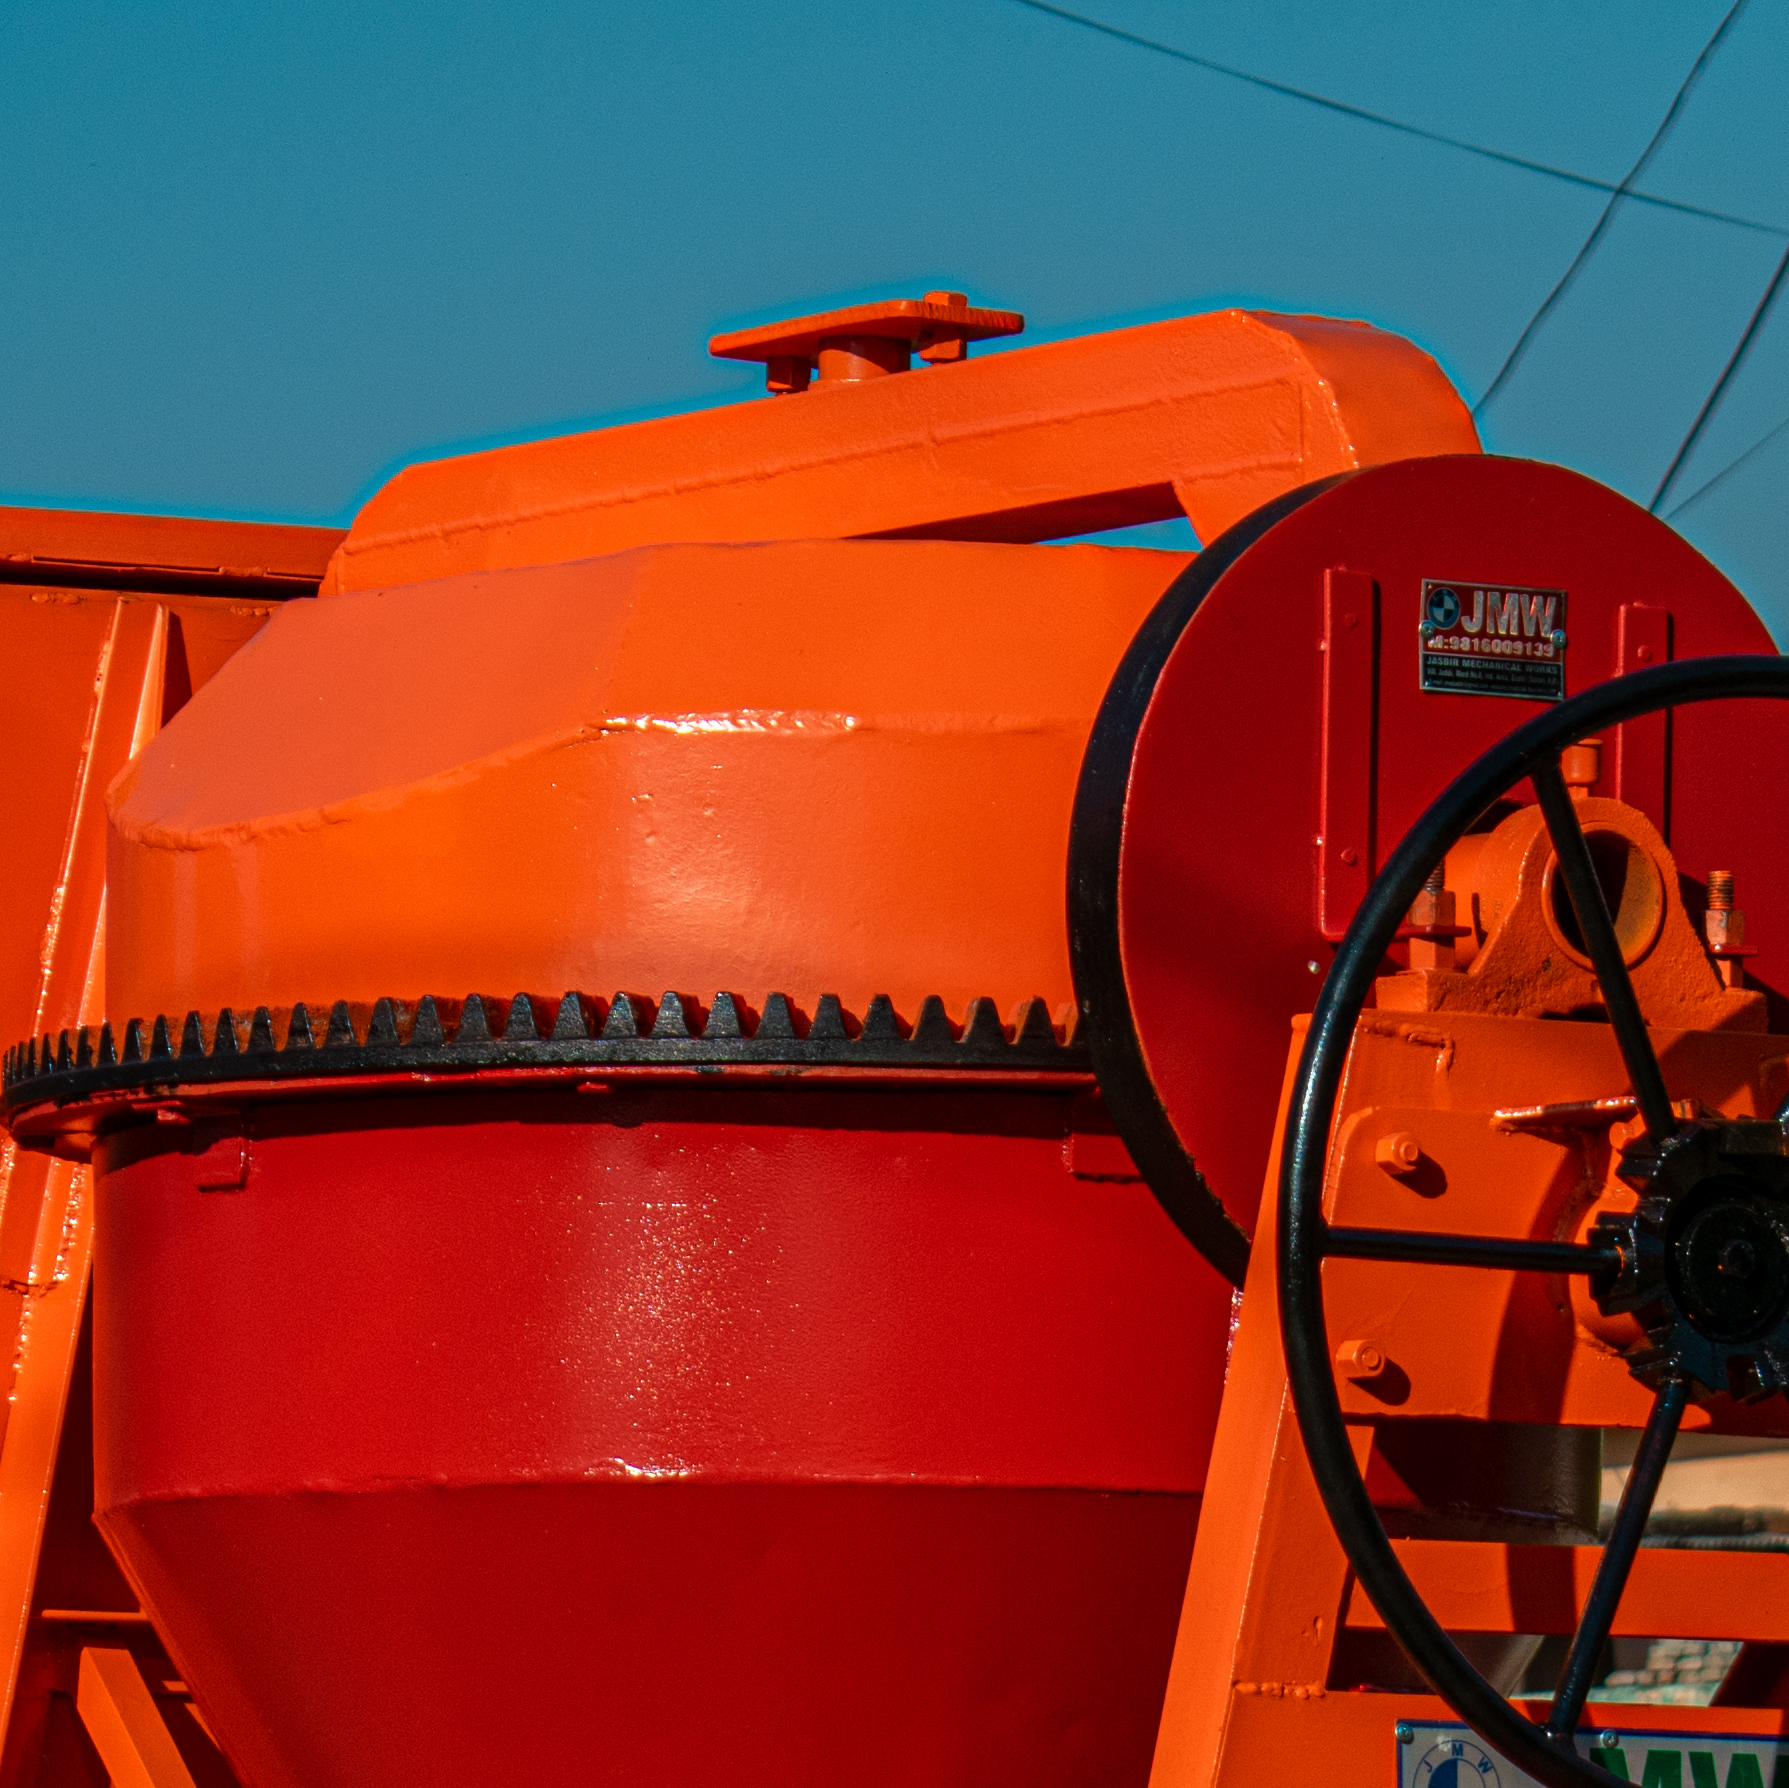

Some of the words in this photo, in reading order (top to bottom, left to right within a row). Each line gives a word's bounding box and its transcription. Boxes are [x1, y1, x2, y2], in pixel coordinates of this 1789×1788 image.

[1461, 590, 1557, 637] JMW
[1426, 656, 1460, 667] JASBIR
[1462, 658, 1521, 672] MECHANICAL
[1524, 664, 1558, 675] WORKS
